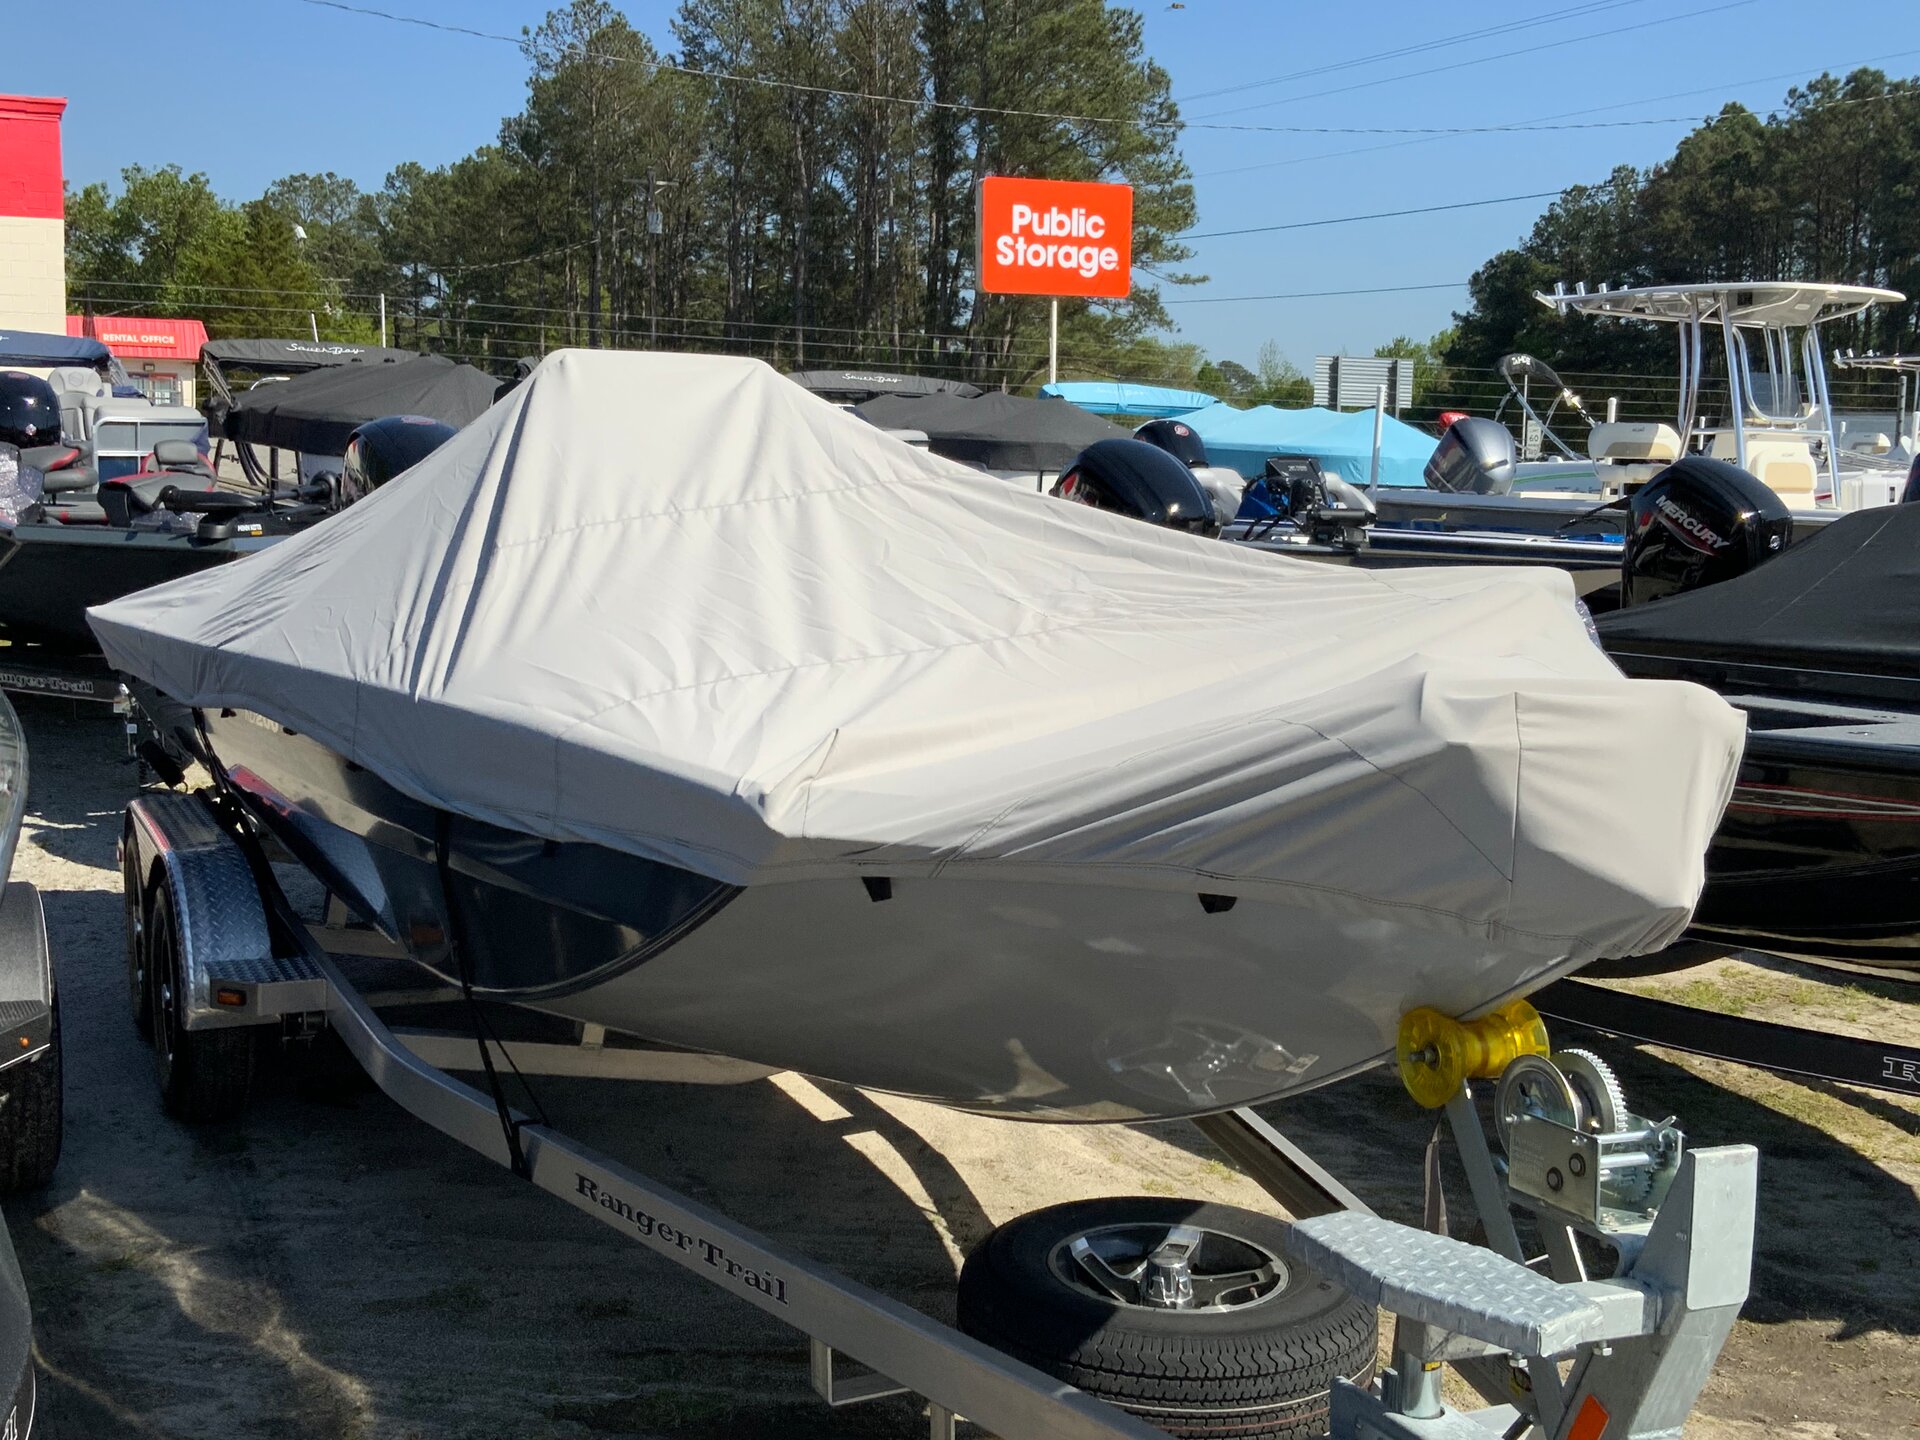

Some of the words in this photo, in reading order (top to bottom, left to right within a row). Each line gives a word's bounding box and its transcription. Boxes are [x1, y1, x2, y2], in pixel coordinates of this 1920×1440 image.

[1012, 204, 1105, 239] Public
[996, 235, 1119, 278] Storage
[102, 333, 139, 344] RENTAL
[140, 335, 176, 345] OFFICE
[1655, 494, 1731, 549] MERCURY
[47, 677, 94, 694] Trail
[575, 1172, 693, 1252] Ranger
[698, 1238, 789, 1305] Trail
